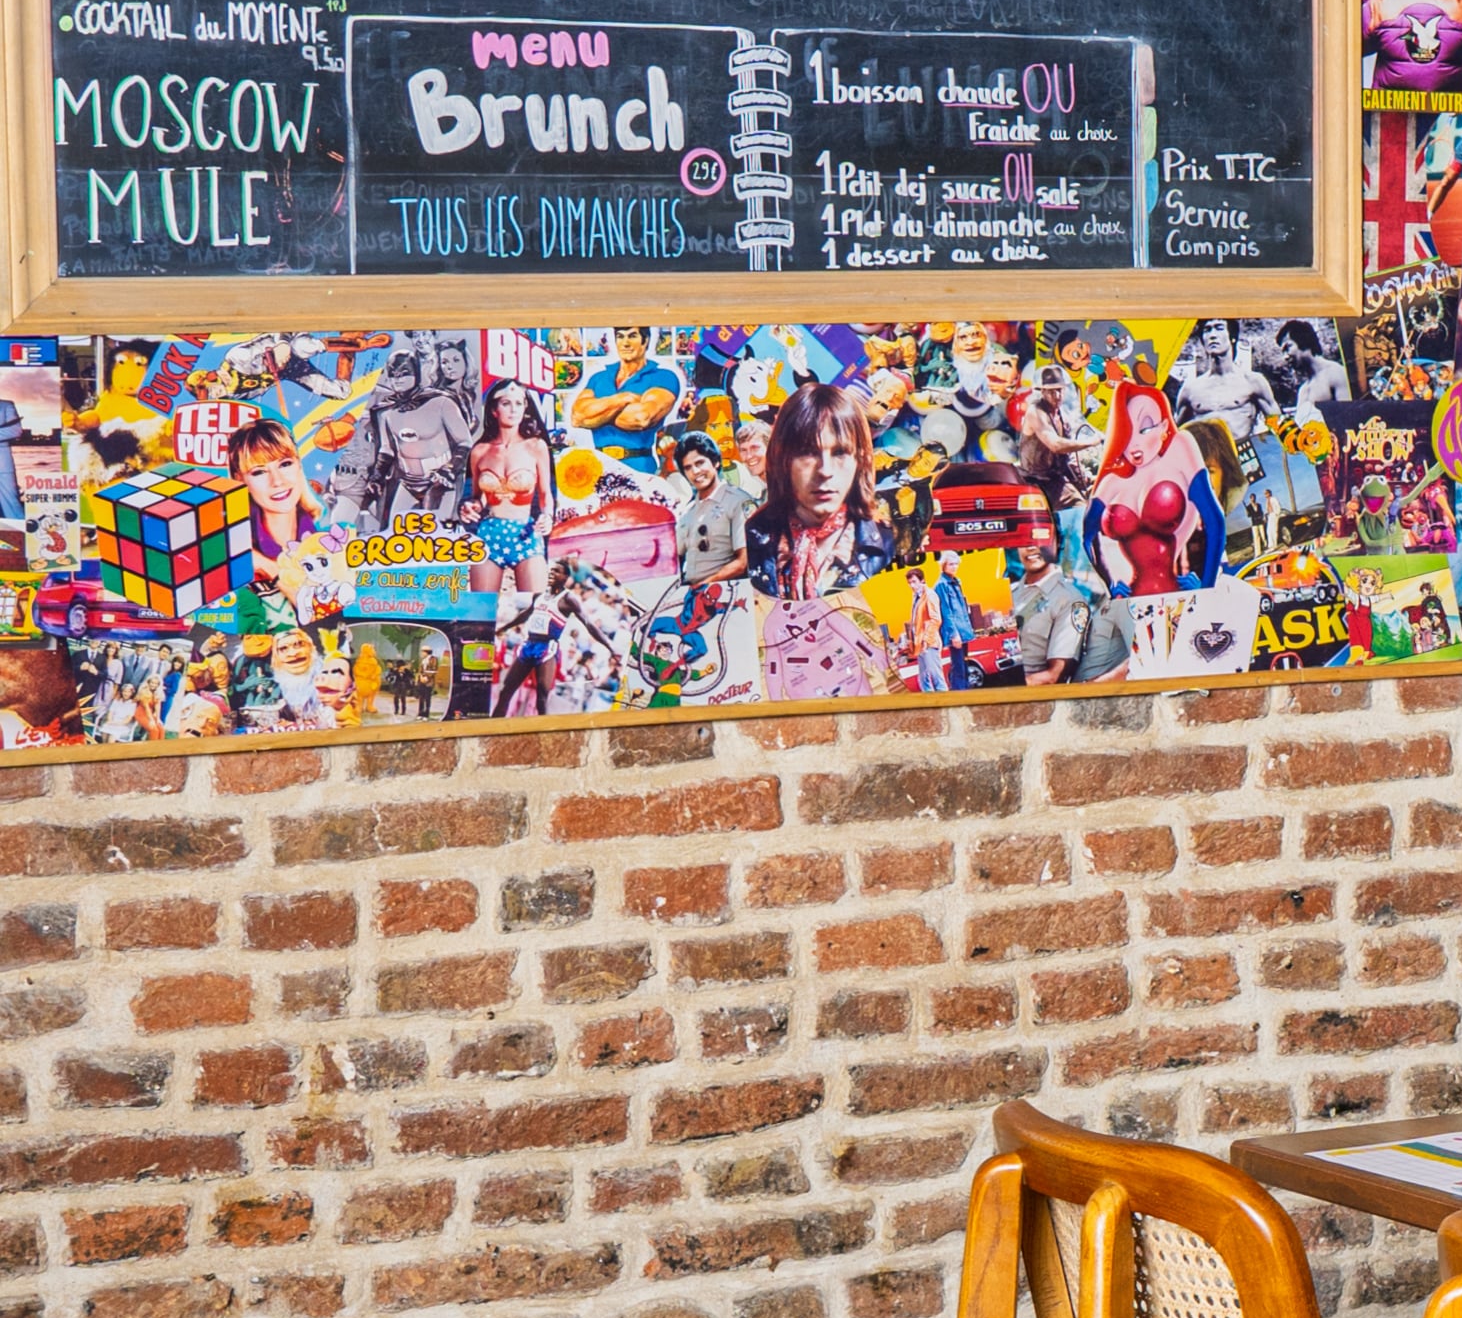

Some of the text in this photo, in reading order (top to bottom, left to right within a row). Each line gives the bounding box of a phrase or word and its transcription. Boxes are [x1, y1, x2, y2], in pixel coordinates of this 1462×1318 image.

[75, 0, 187, 41] COCKTAIL
[195, 12, 226, 41] du
[472, 30, 610, 70] menu
[832, 62, 1076, 114] boisson chaude OU
[55, 73, 320, 153] MOSCOW
[407, 66, 685, 155] Brunch
[1050, 127, 1070, 141] au
[1003, 152, 1034, 203] OU
[1161, 147, 1213, 183] Prix
[87, 166, 271, 247] MULE
[893, 213, 924, 237] du
[933, 211, 1049, 238] dimanche
[1053, 223, 1077, 236] au
[1165, 189, 1251, 230] Service
[390, 195, 685, 259] TOUS LES DIMANCHES
[847, 243, 936, 267] dessert
[951, 248, 983, 263] au
[1166, 229, 1261, 264] Compris
[488, 329, 554, 390] BIG
[25, 474, 78, 491] Donald
[393, 512, 437, 535] LES
[957, 519, 1006, 532] 205 GTI
[346, 532, 487, 567] BRONZÉS
[360, 596, 426, 616] Casimir
